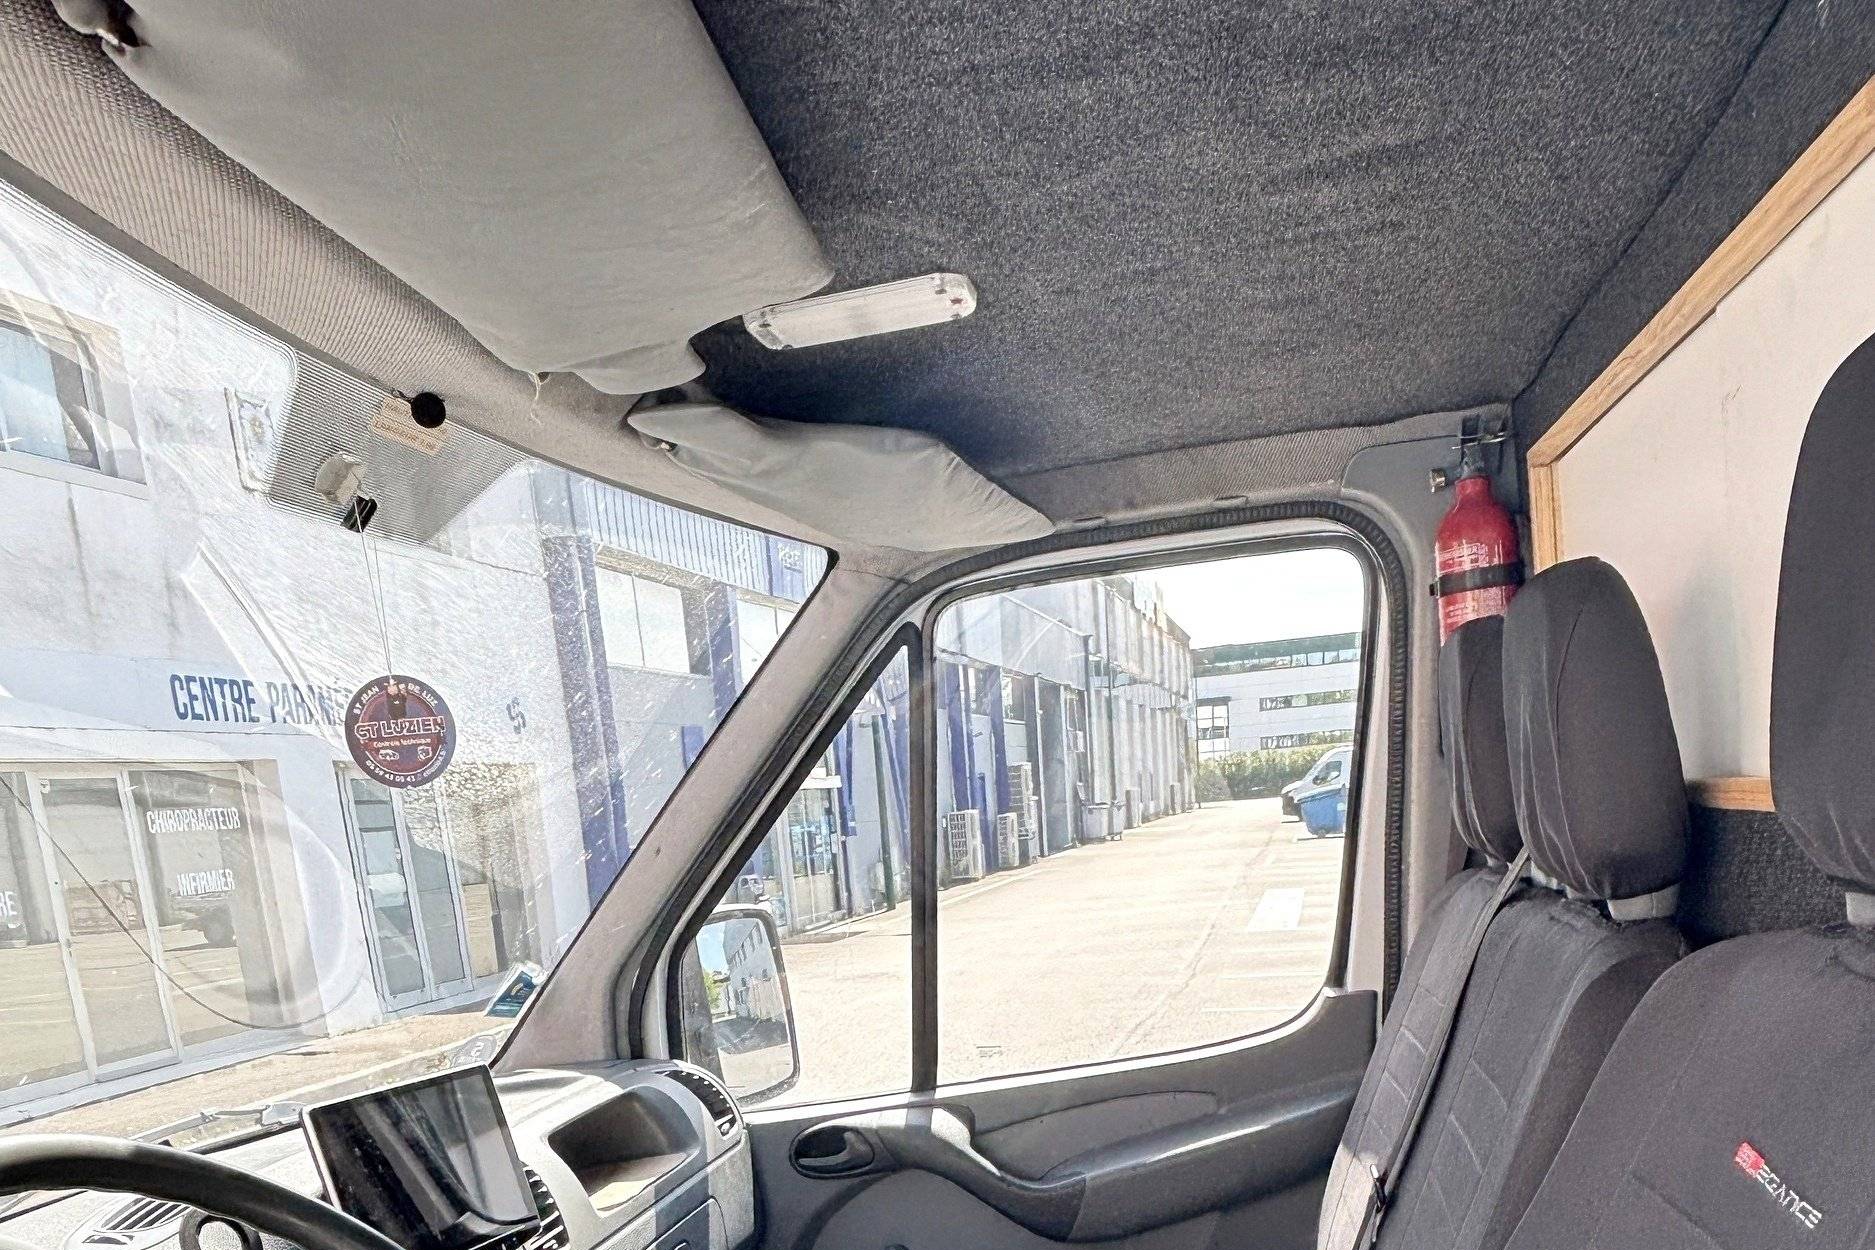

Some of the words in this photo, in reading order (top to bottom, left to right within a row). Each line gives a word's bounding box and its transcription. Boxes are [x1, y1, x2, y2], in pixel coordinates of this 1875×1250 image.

[169, 673, 260, 723] CENTRE
[146, 807, 241, 834] CHIROPRACTEUR
[177, 868, 236, 897] INFIRMIER
